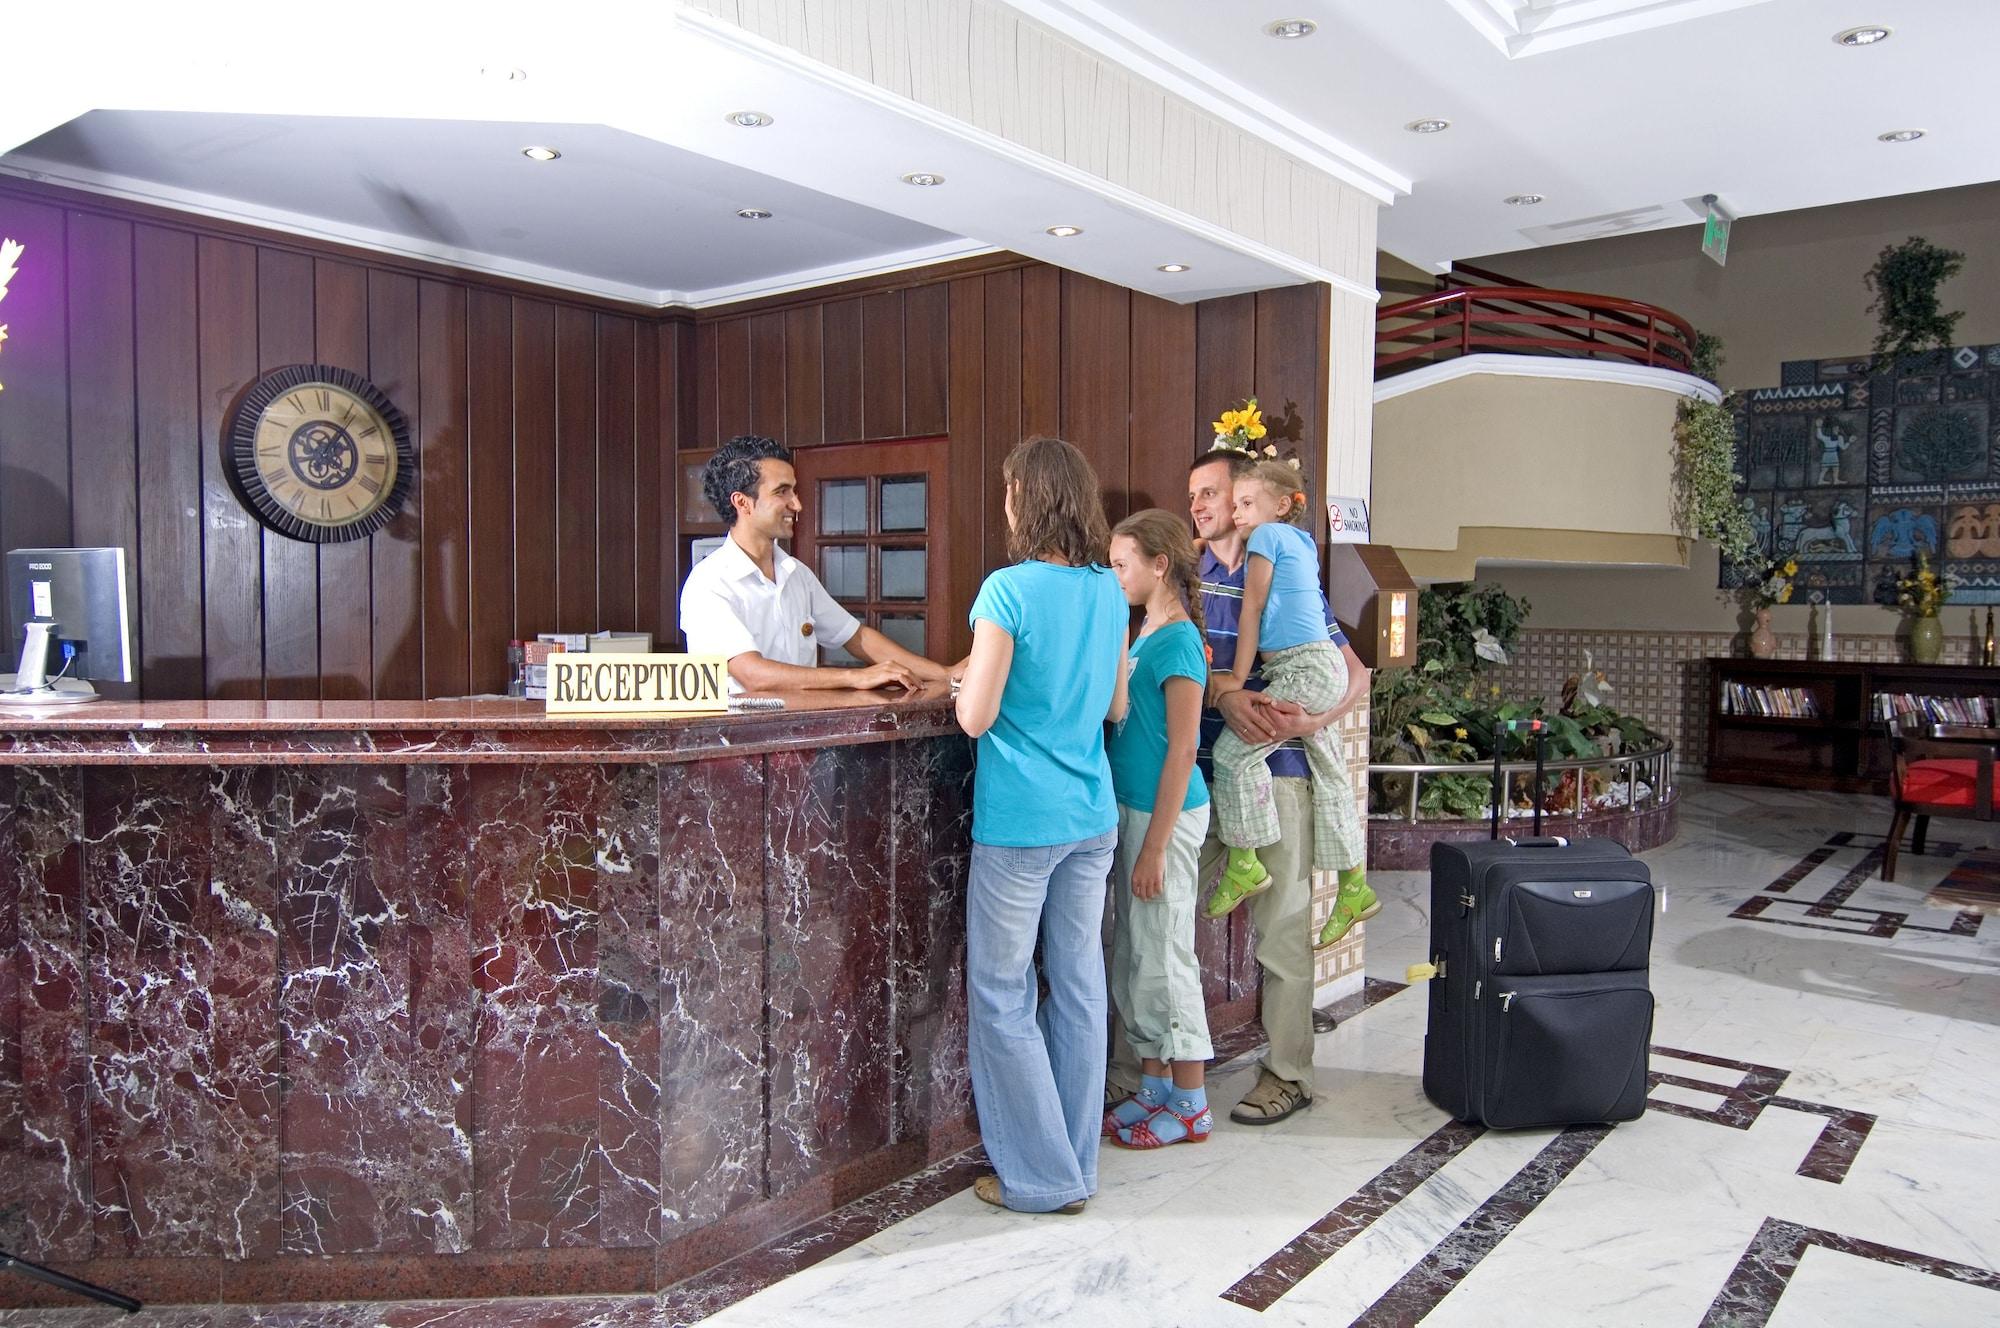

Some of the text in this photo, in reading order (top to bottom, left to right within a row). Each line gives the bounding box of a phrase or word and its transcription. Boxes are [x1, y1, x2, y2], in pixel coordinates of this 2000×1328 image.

[1349, 507, 1358, 518] NO
[1344, 519, 1367, 532] SMOKING
[554, 663, 720, 702] RECEPTION
